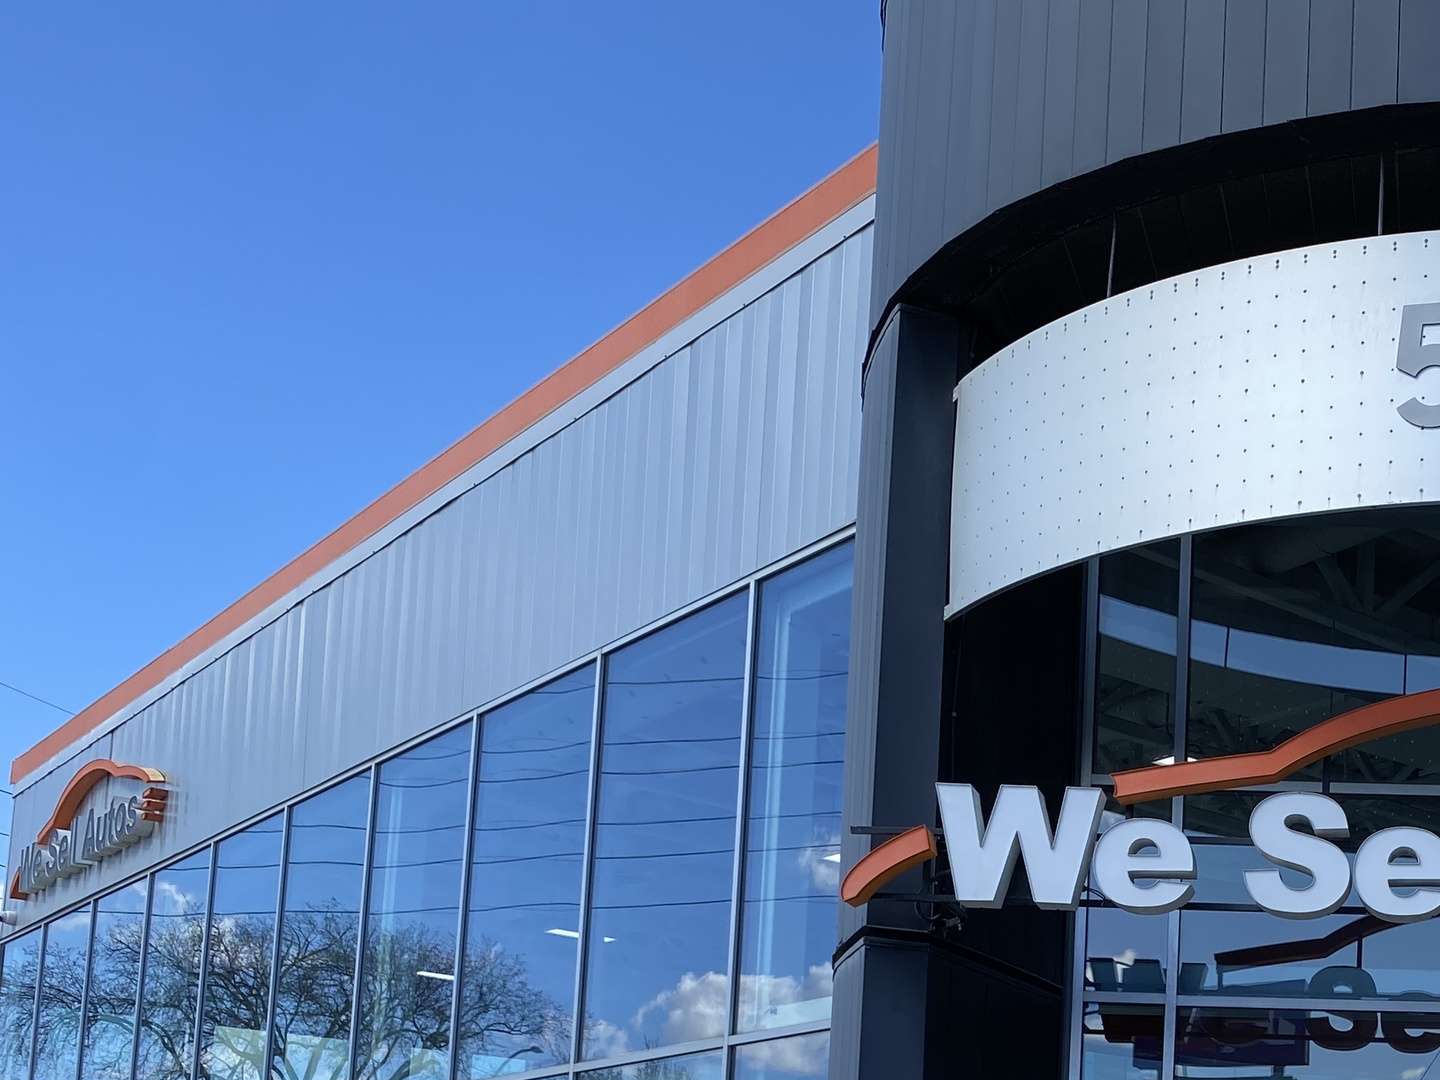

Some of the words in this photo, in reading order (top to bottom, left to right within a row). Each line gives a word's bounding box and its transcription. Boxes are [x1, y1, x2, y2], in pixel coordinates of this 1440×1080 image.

[19, 842, 46, 893] We
[80, 796, 142, 861] Autos
[935, 782, 1198, 914] We
